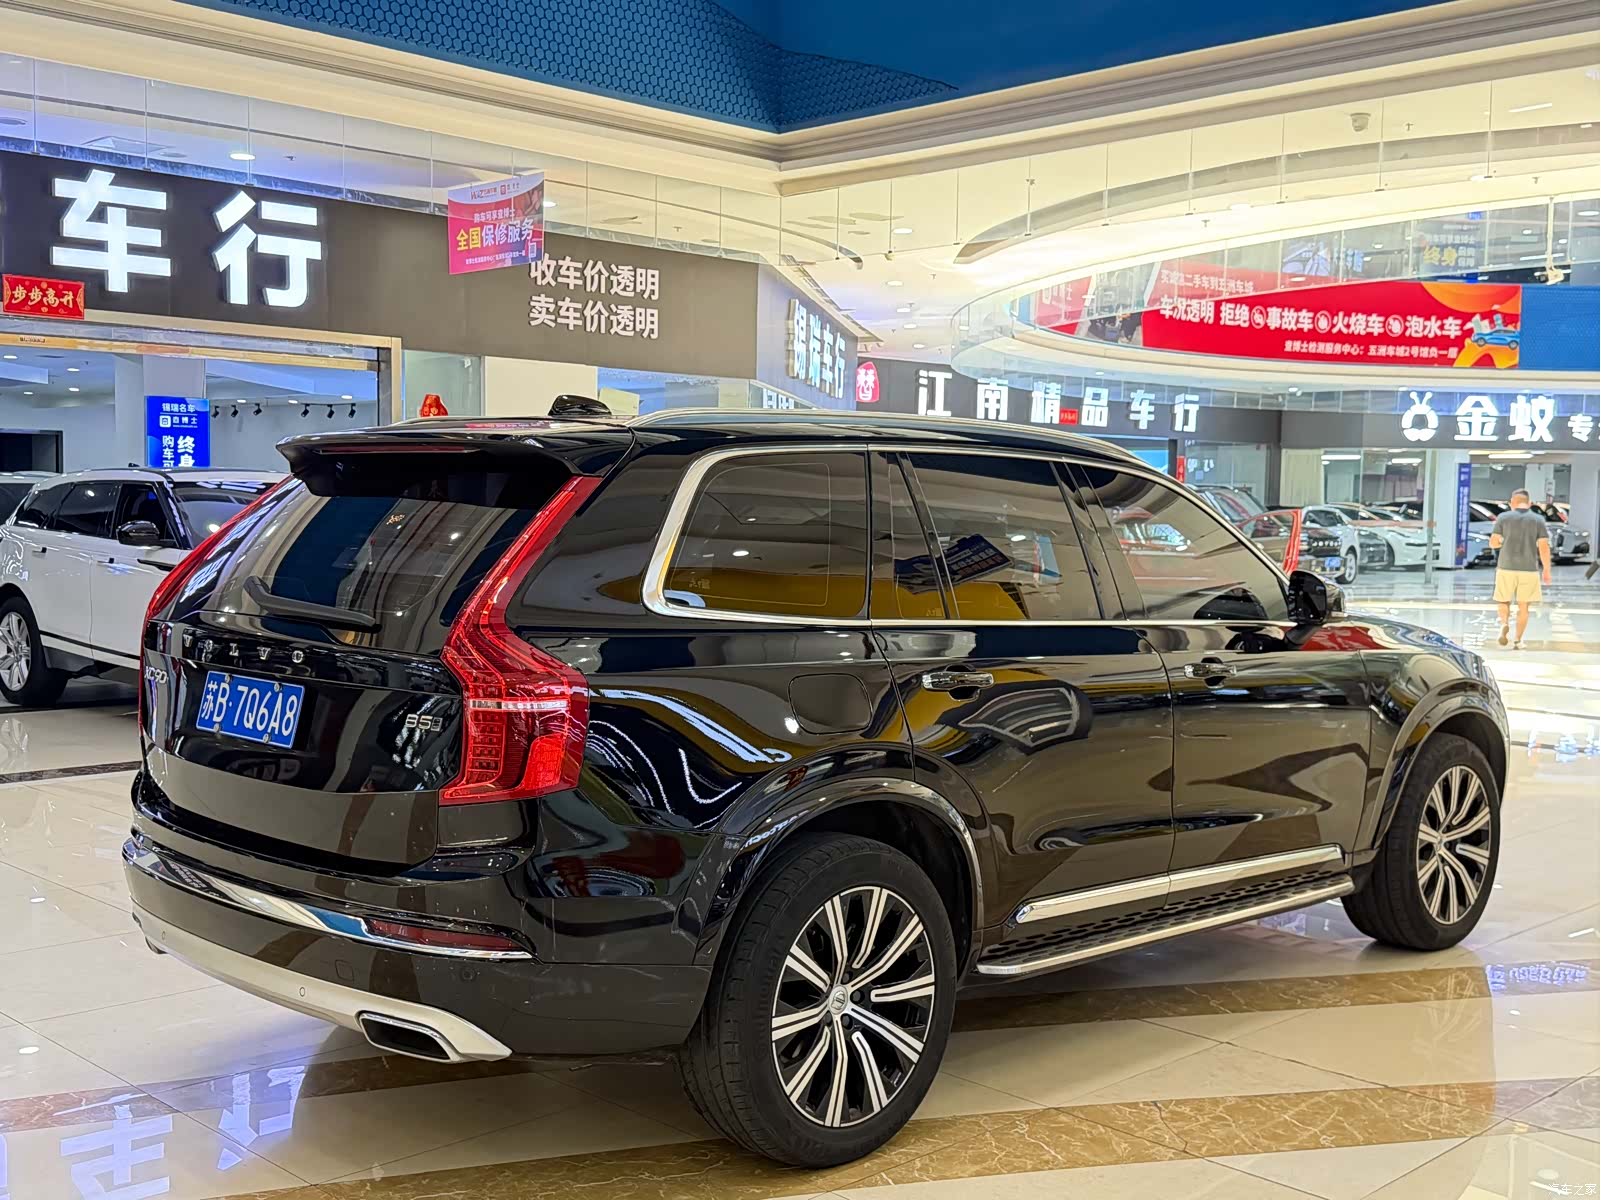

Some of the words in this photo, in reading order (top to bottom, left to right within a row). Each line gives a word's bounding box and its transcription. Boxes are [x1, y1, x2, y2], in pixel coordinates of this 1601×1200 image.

[51, 168, 323, 308] 车行
[456, 217, 535, 251] 全国保修服务
[11, 284, 74, 308] 步步高升
[529, 253, 660, 300] 收车价透明
[529, 294, 660, 340] 卖车价透明
[1160, 294, 1216, 325] 车况透明
[1219, 301, 1250, 328] 拒绝
[1266, 305, 1315, 333] 事故车
[1331, 311, 1385, 337] 火烧车
[1404, 315, 1463, 340] 泡水车
[162, 403, 196, 413] 锡瑞名车
[917, 369, 1200, 433] 江南精品车行
[1453, 395, 1555, 442] 金蚁
[1568, 413, 1601, 443] 专
[177, 435, 196, 468] 终身
[183, 633, 304, 664] VOLVO
[144, 665, 168, 684] XC90
